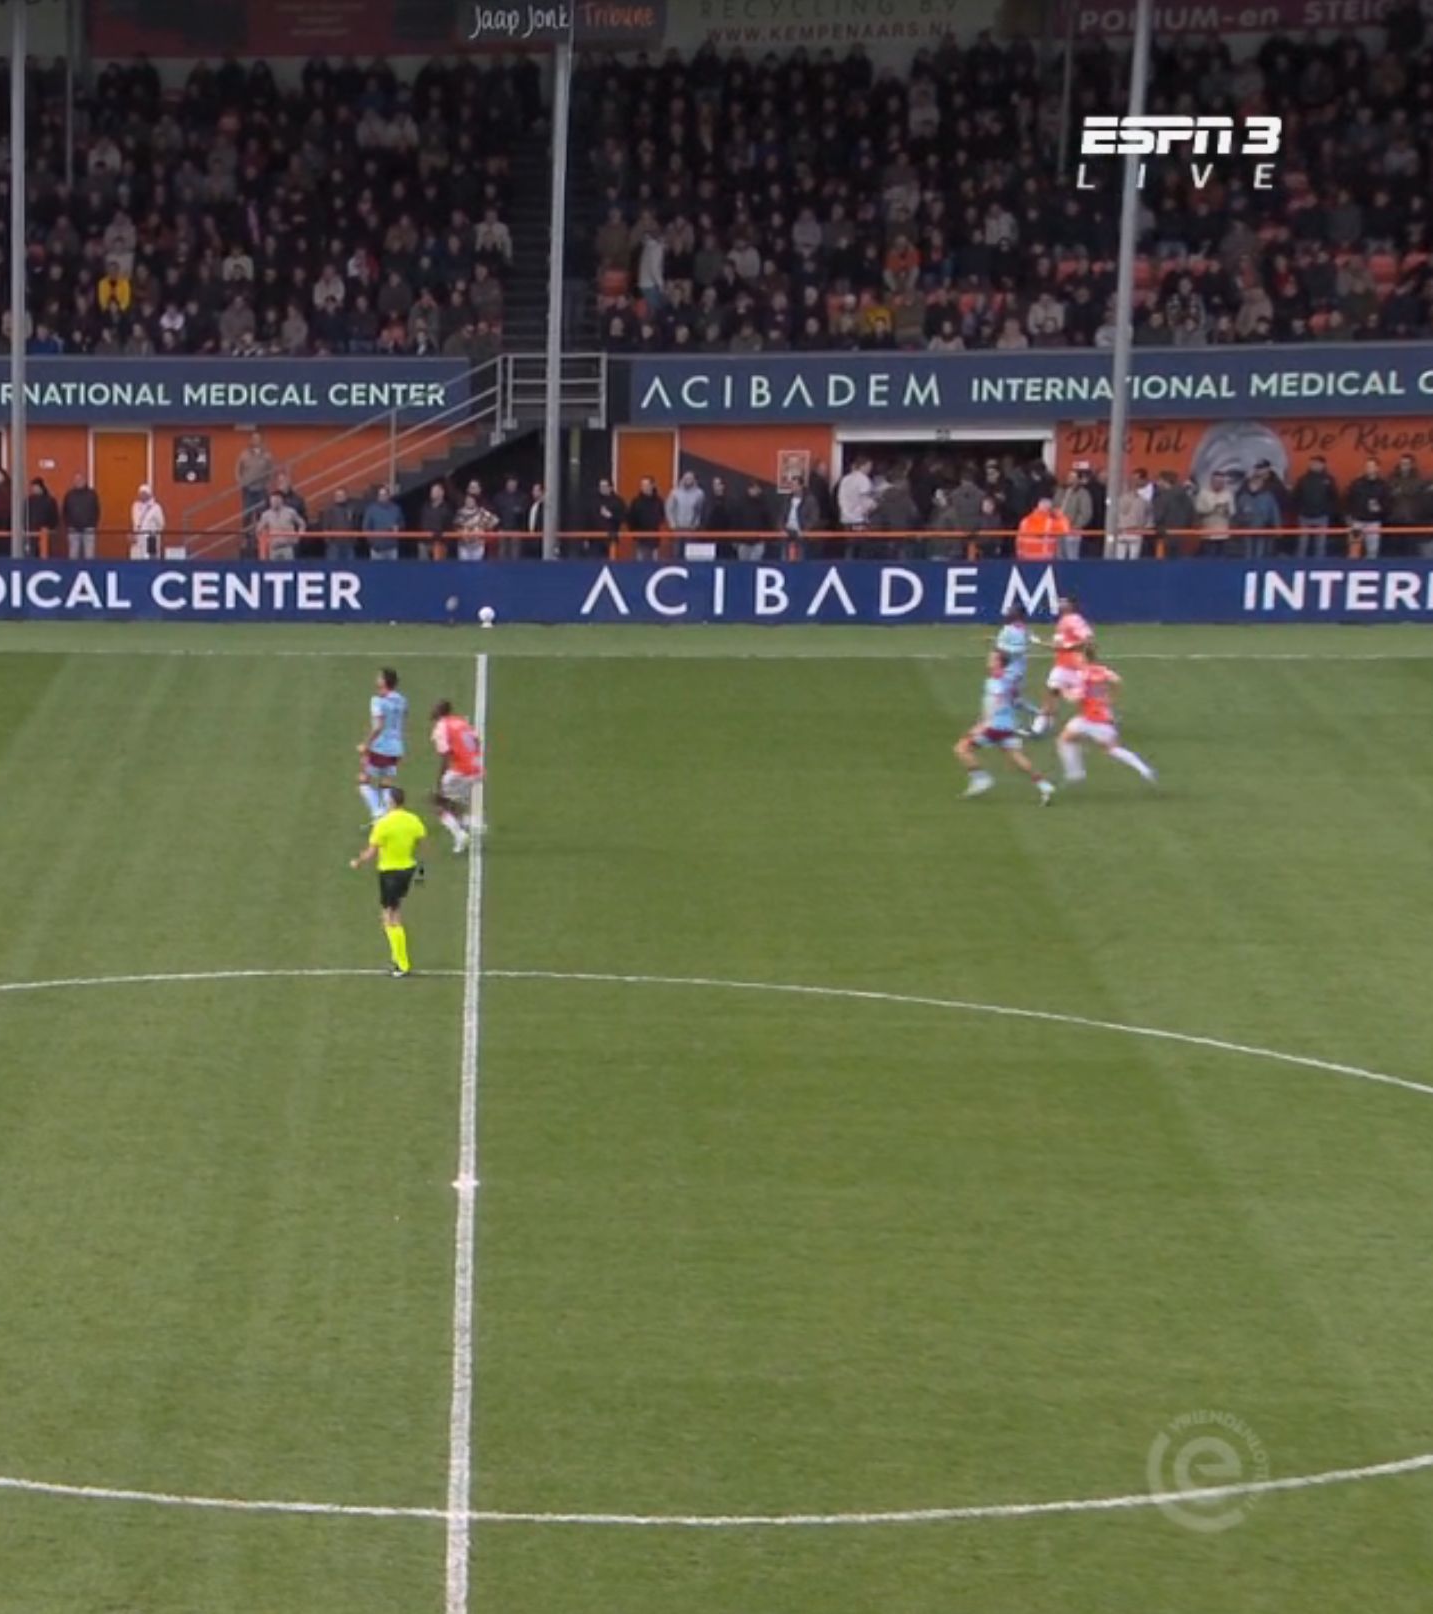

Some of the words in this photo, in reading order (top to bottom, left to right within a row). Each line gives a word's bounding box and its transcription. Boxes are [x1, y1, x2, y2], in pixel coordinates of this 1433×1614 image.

[183, 383, 318, 407] MEDICAL
[329, 383, 445, 407] CENTER
[1250, 370, 1406, 398] MEDICAL
[151, 570, 362, 611] CENTER
[1243, 570, 1433, 611] INTER
